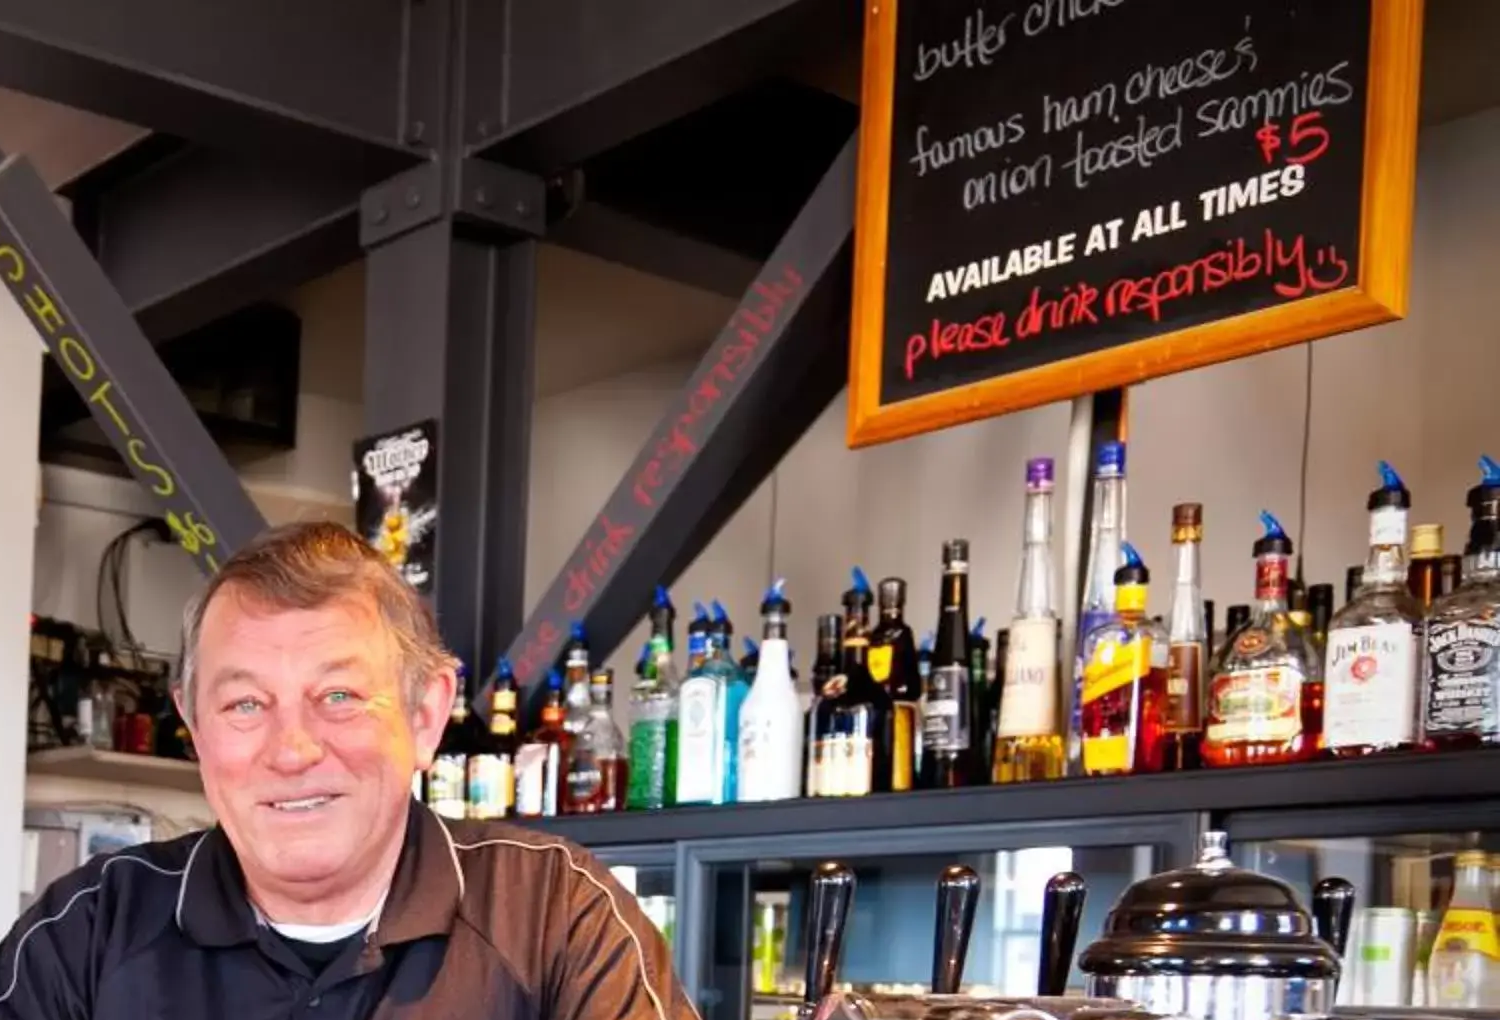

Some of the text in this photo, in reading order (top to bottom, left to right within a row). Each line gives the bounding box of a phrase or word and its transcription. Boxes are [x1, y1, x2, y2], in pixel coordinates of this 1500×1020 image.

[913, 8, 1016, 81] butter
[909, 114, 1025, 176] famous
[962, 61, 1354, 210] onion toasted sammies
[1256, 111, 1330, 165] $5
[927, 163, 1306, 303] AVAILABLE AT ALL TIMES
[904, 229, 1309, 379] please drink responsibly
[565, 512, 635, 611] drink
